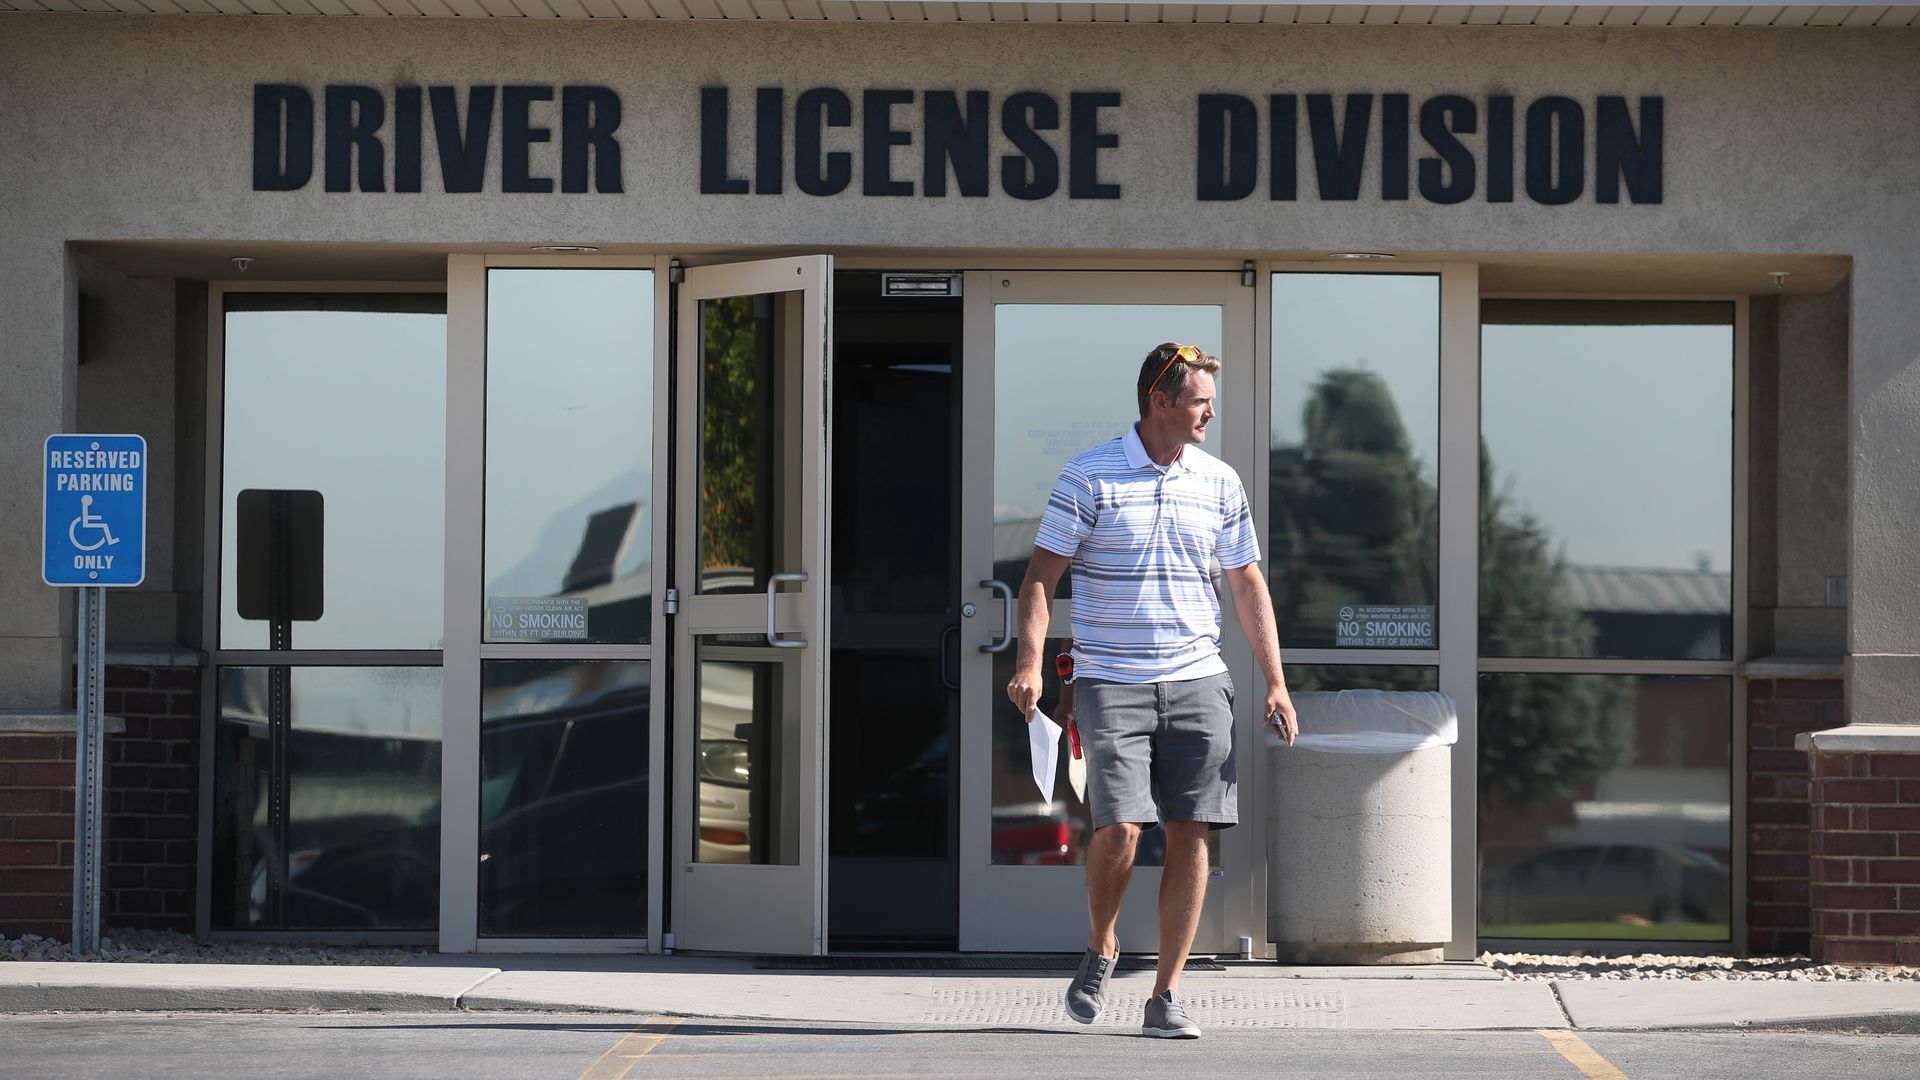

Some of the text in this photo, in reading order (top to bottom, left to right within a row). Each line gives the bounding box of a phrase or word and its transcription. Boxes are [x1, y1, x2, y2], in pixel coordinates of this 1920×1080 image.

[252, 82, 1665, 206] DRIVER LICENSE DIVISION
[51, 450, 140, 469] RESERVED
[57, 473, 134, 491] PARKING
[73, 555, 114, 569] ONLY
[493, 613, 585, 628] NO SMOKING
[494, 629, 585, 638] WITHIN 25 FT OF BUILDING
[1338, 621, 1431, 636] NO SMOKING
[1339, 638, 1432, 646] WITHIN 25 FT OF BUILDING
